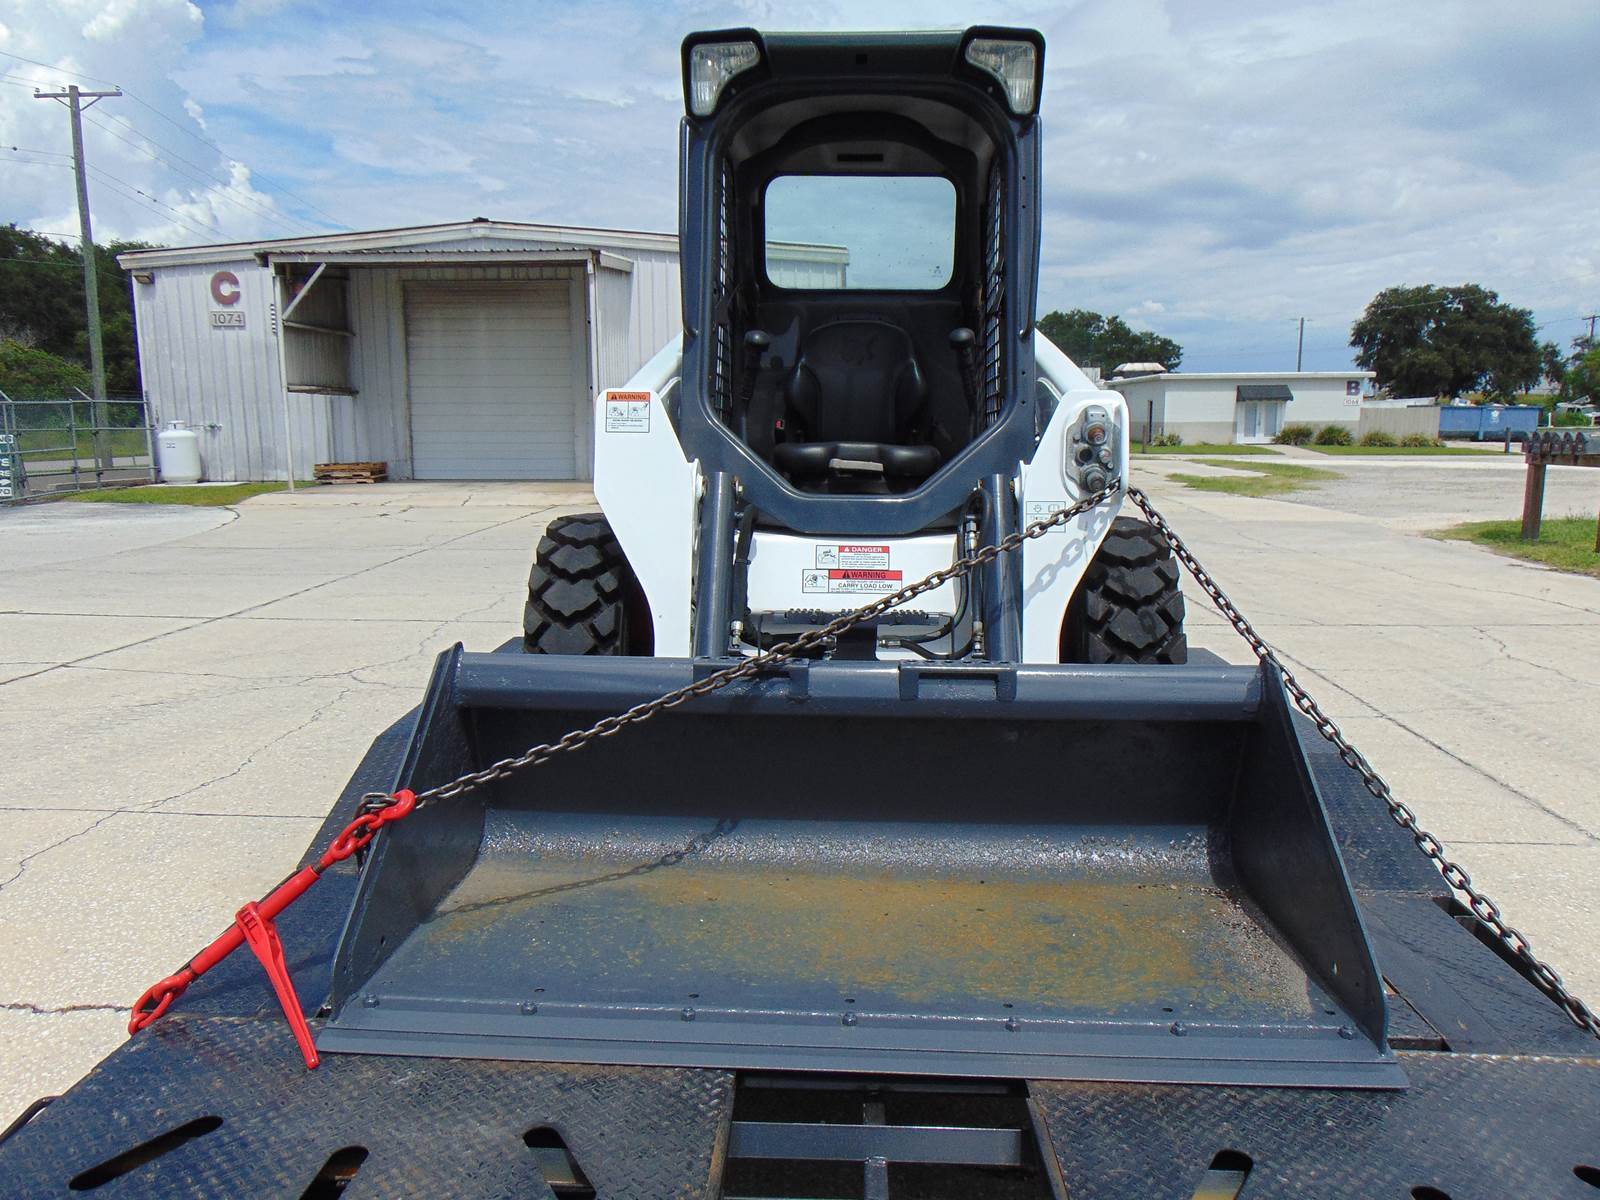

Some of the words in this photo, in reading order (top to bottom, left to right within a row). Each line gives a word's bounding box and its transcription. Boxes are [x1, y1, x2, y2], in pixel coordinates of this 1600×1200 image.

[211, 271, 241, 305] C
[213, 313, 242, 324] 1074
[1346, 381, 1360, 395] B
[851, 571, 887, 579] WARNING
